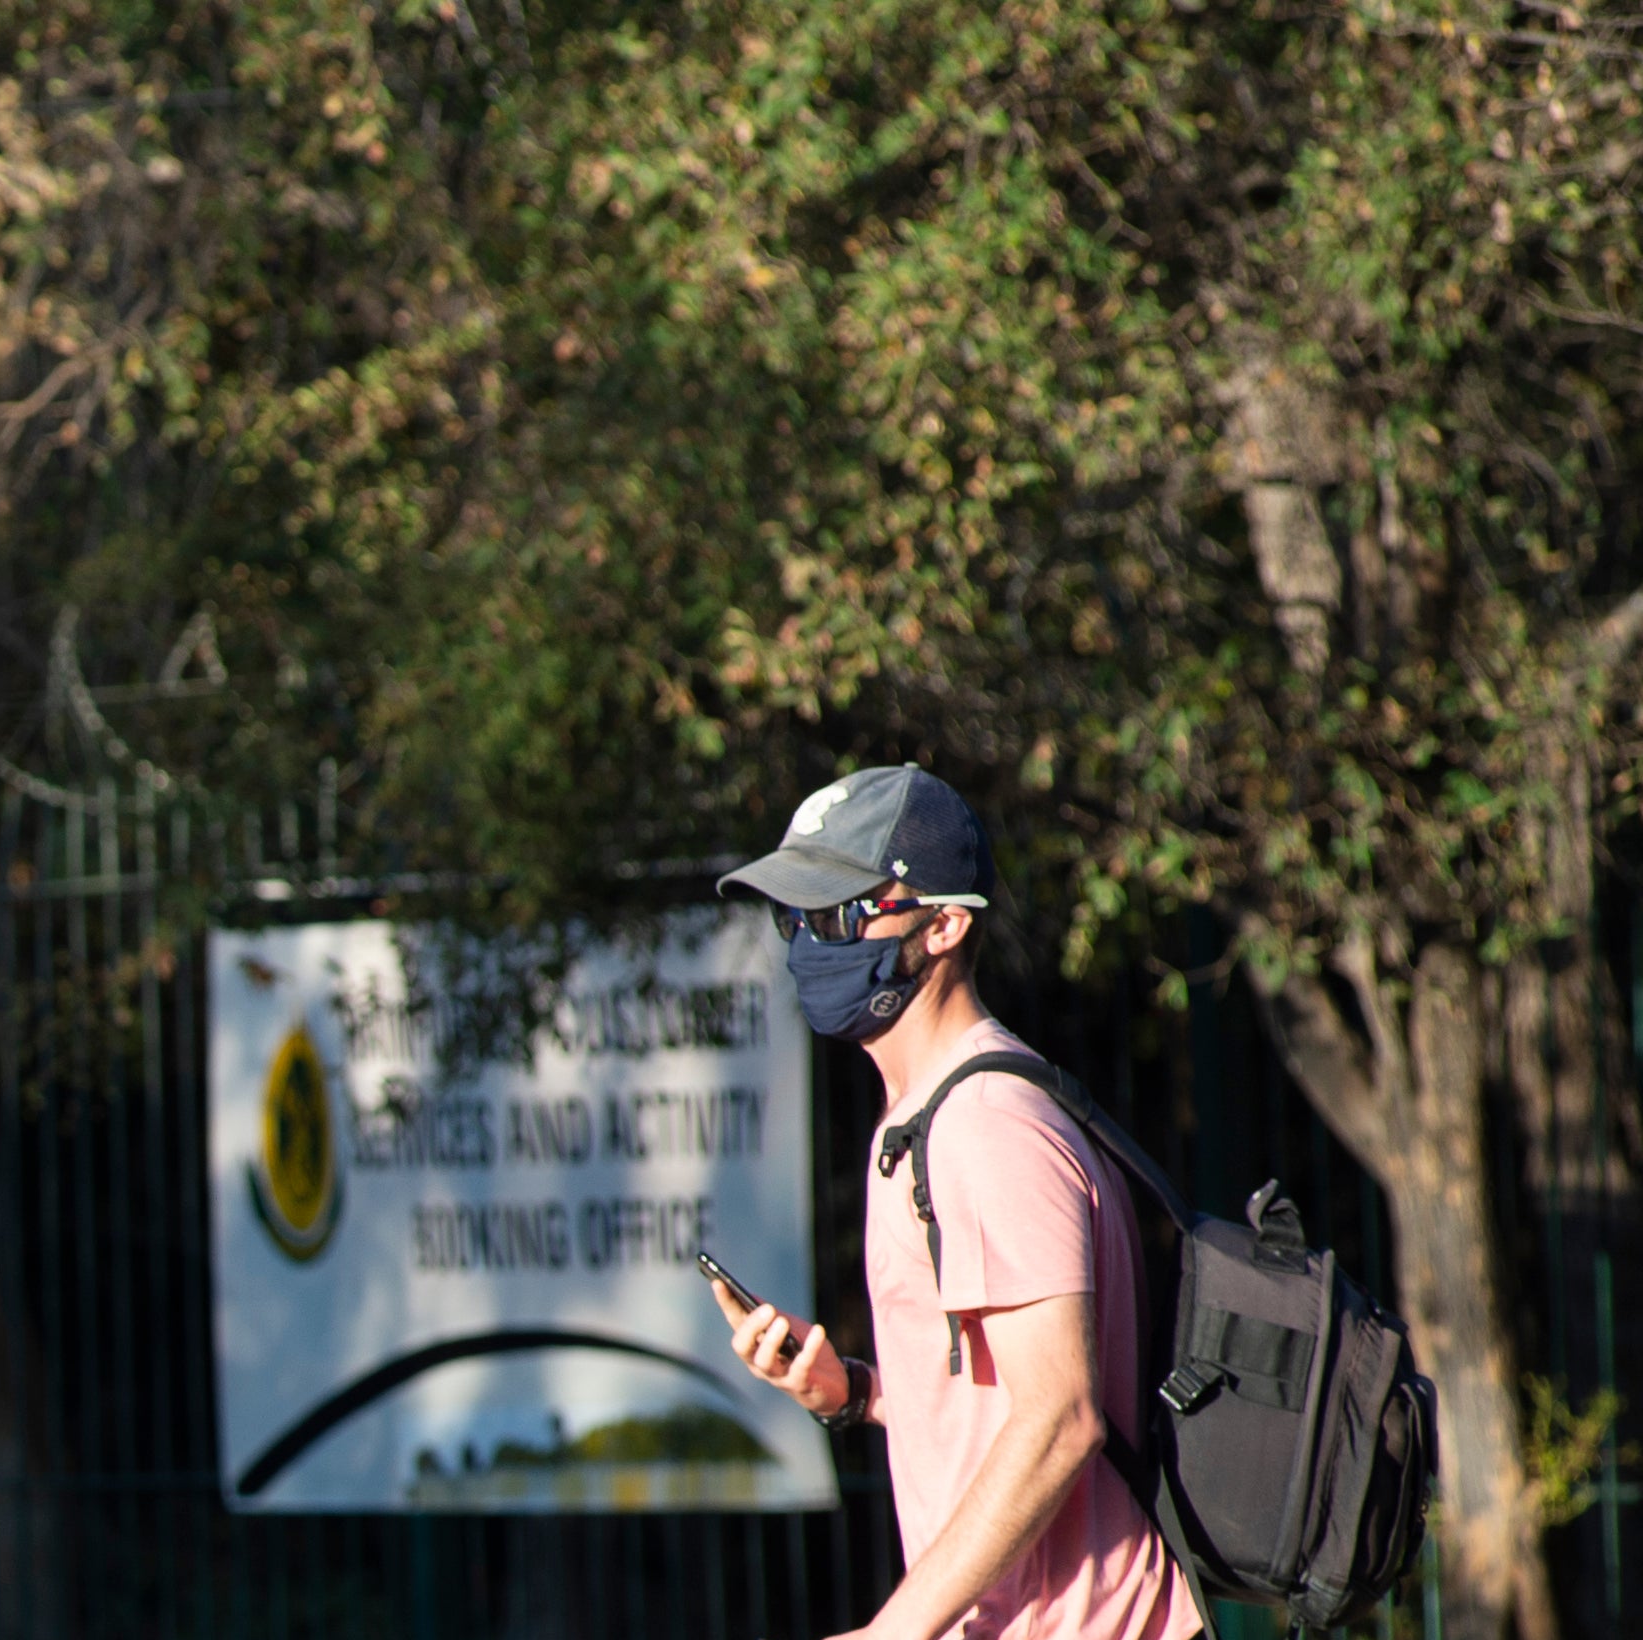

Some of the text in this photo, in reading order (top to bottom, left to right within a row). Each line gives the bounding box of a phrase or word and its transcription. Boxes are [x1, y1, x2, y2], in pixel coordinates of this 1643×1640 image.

[511, 1093, 596, 1167] AND
[605, 1084, 770, 1159] ACTIVITY
[415, 1195, 713, 1273] BOOKING OFFICE
